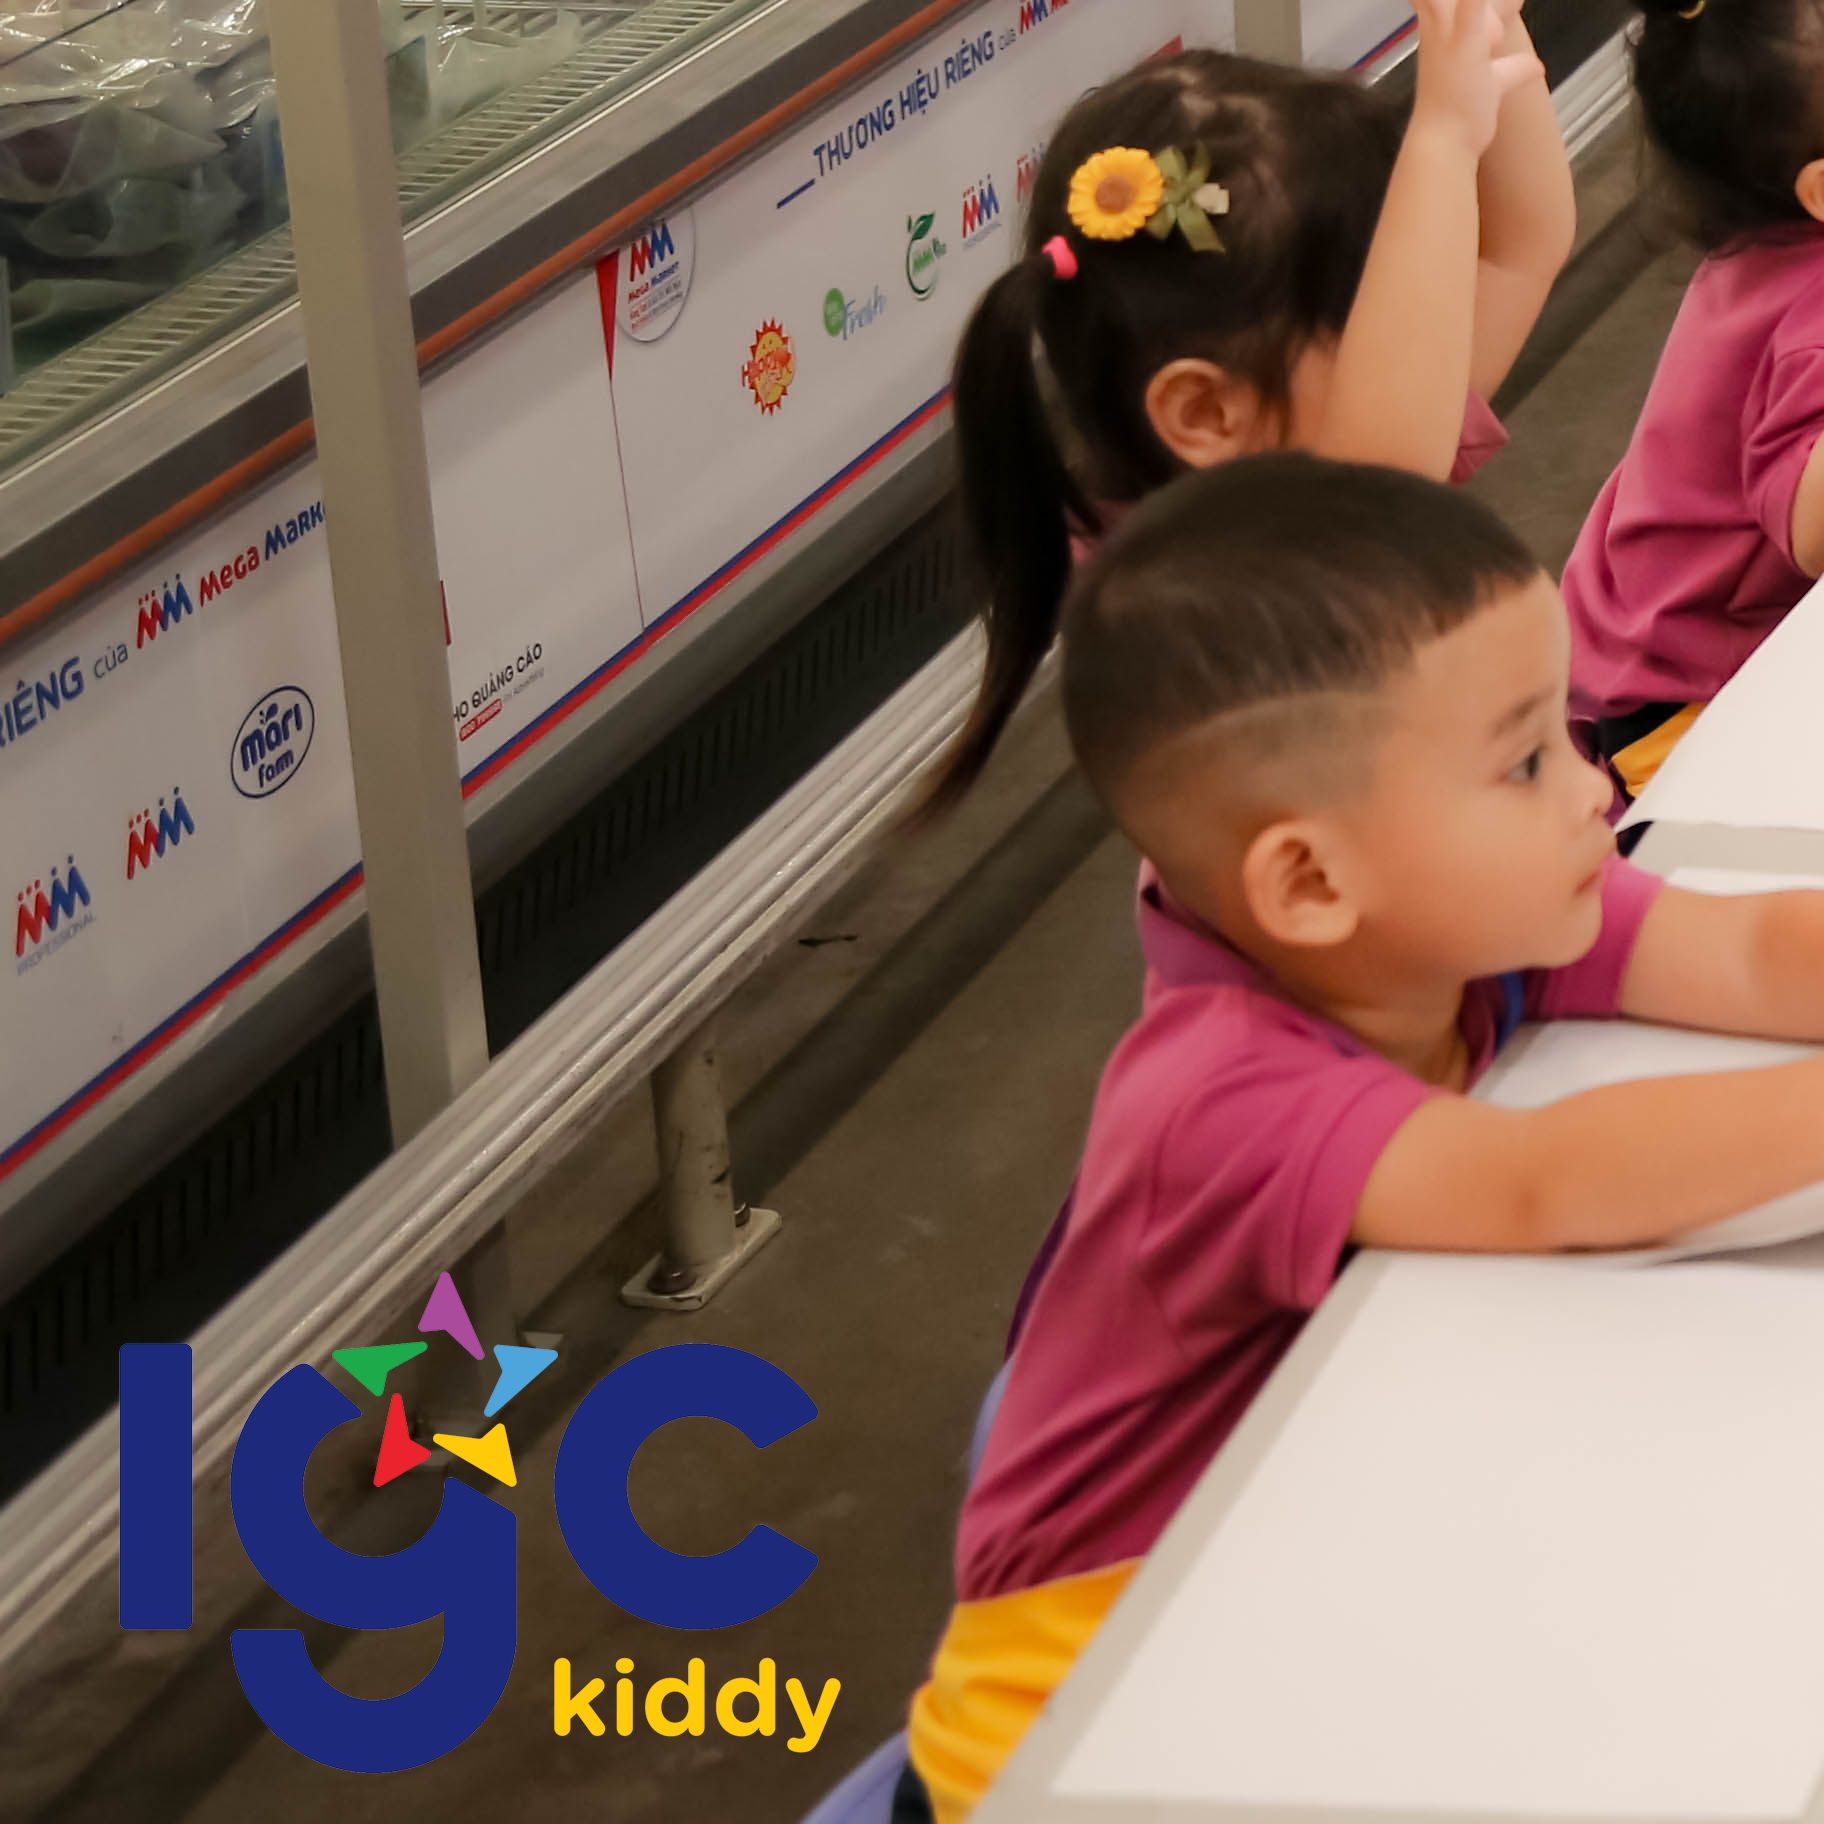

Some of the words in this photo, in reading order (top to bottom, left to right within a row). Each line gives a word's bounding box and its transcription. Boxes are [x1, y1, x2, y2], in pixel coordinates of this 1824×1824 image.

[814, 98, 896, 176] THƯƠNG
[899, 67, 940, 116] HIỆU
[943, 28, 995, 91] RIÊNG
[93, 641, 129, 678] của
[200, 545, 260, 608] Mega
[472, 665, 514, 709] QUẢNG
[516, 642, 543, 673] CÁO
[258, 749, 294, 789] farm
